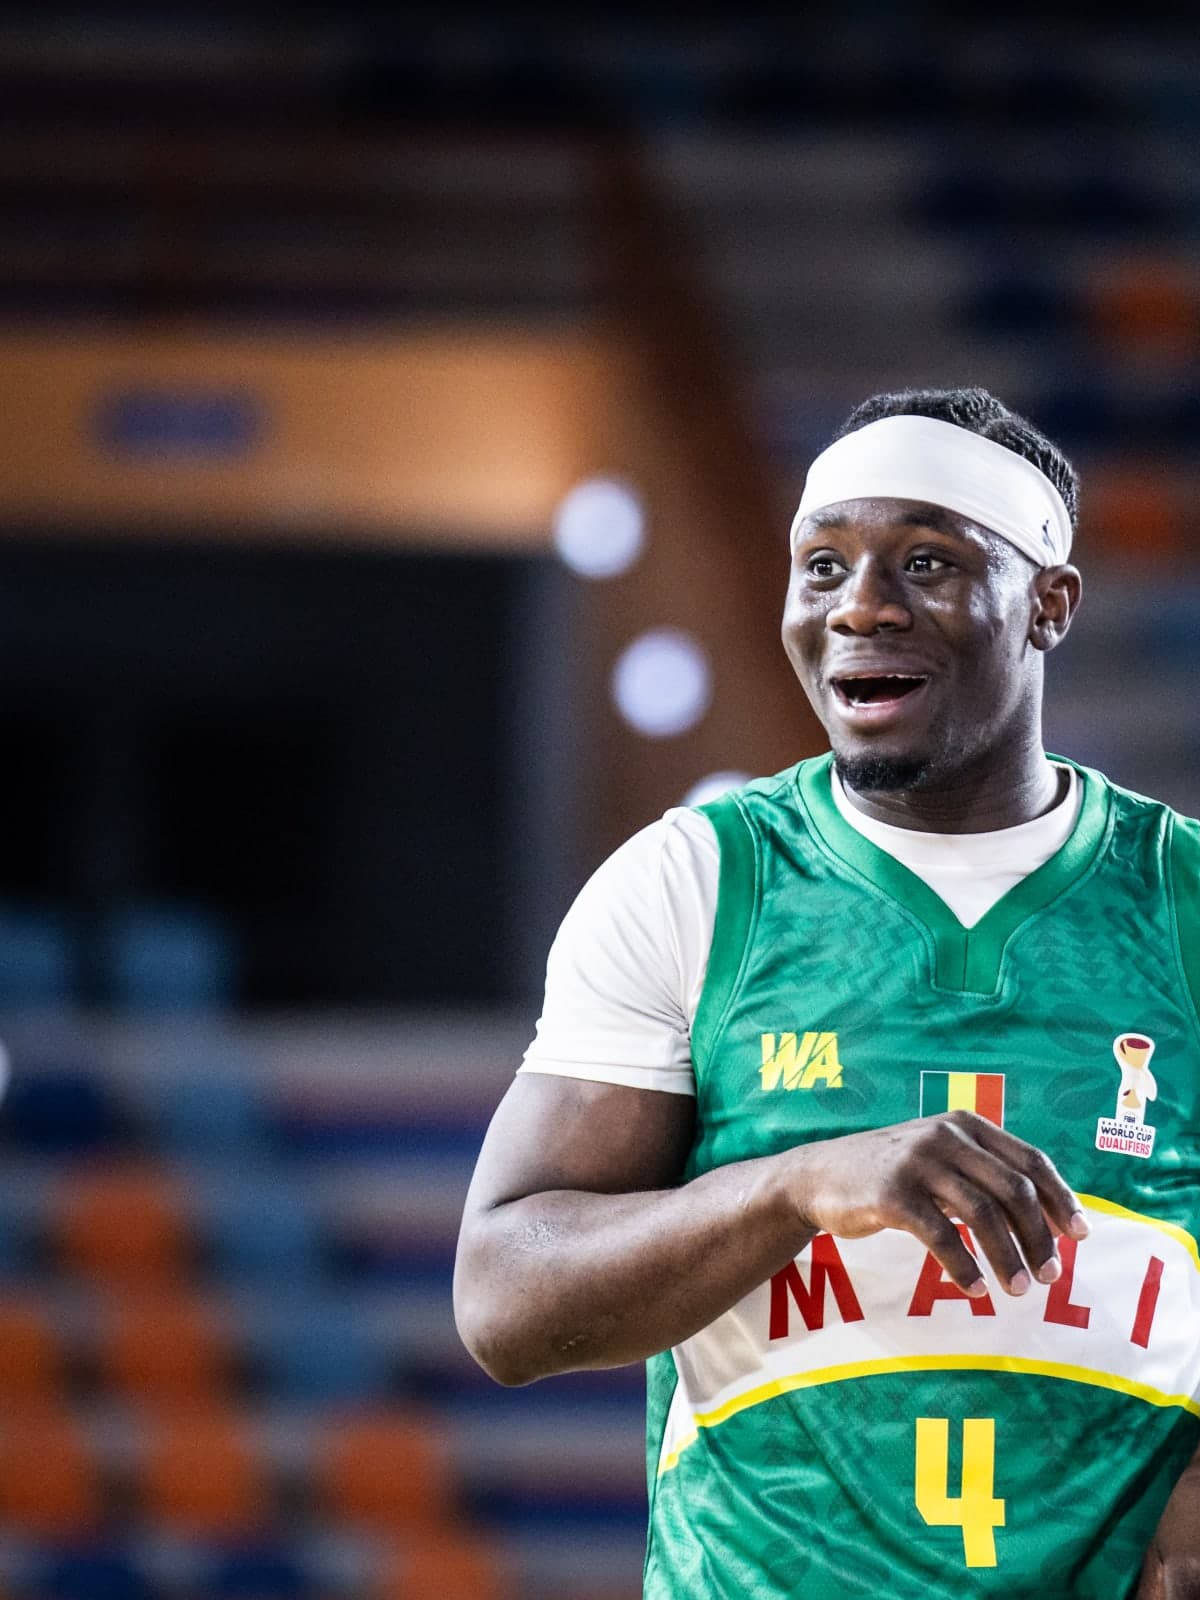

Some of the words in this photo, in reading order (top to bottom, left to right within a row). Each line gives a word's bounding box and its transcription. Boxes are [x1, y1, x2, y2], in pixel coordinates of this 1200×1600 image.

[759, 1032, 842, 1090] WA
[1099, 1136, 1150, 1156] QUALIFIERS
[1101, 1126, 1135, 1139] WORLD
[1136, 1132, 1152, 1142] CUP
[768, 1222, 1164, 1349] MALI
[915, 1417, 1005, 1567] 4
